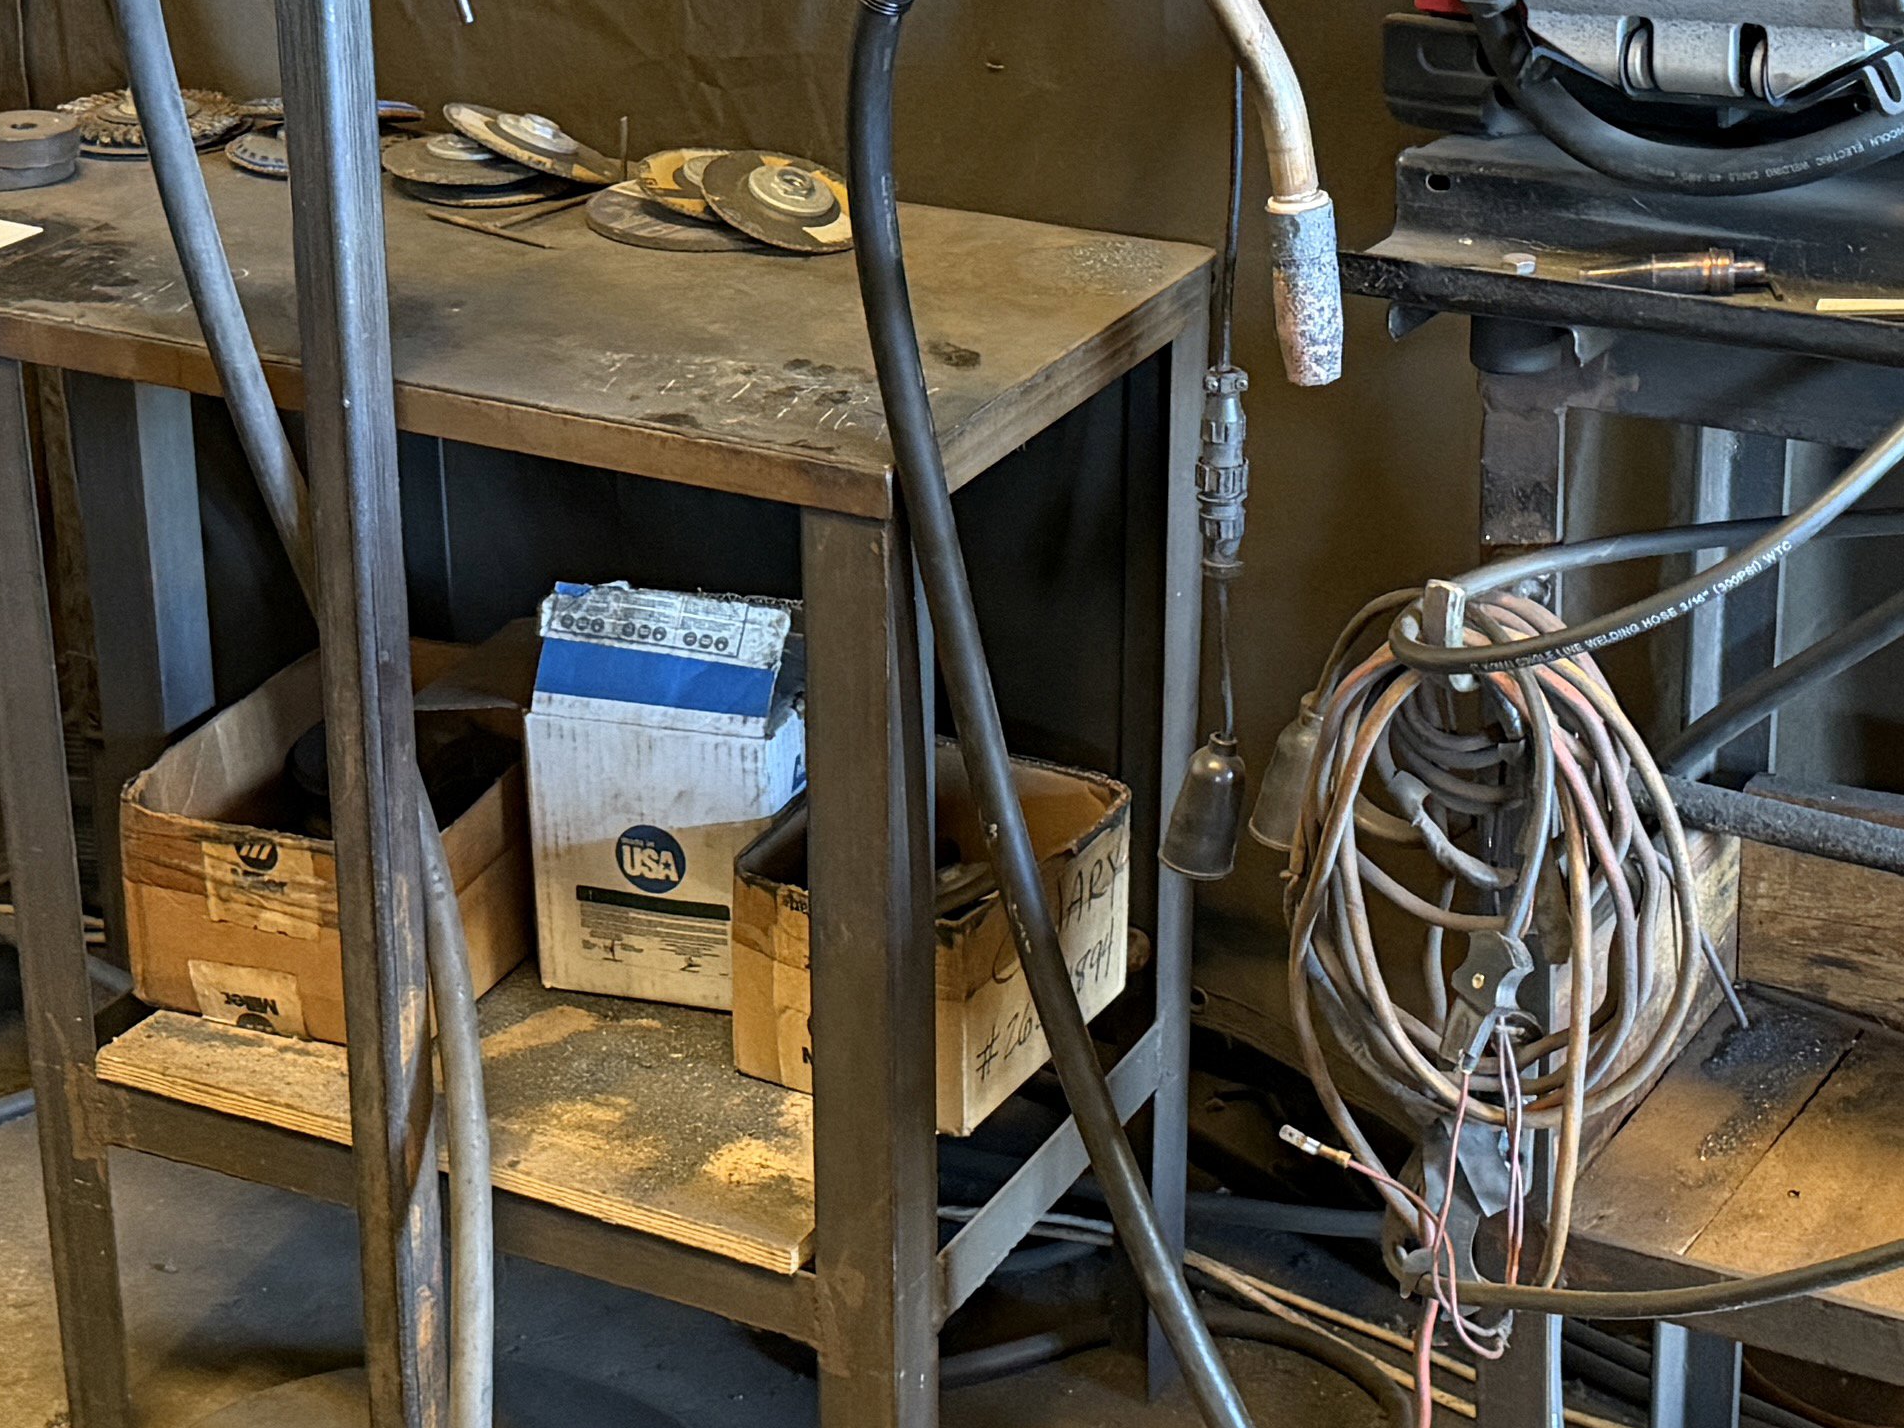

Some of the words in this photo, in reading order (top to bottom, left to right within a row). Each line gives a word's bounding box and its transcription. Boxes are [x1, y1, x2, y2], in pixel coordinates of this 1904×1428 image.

[1815, 141, 1865, 168] ELECTRIC
[1584, 622, 1641, 649] WELDING
[1643, 606, 1678, 629] HOSE
[622, 845, 679, 882] USA
